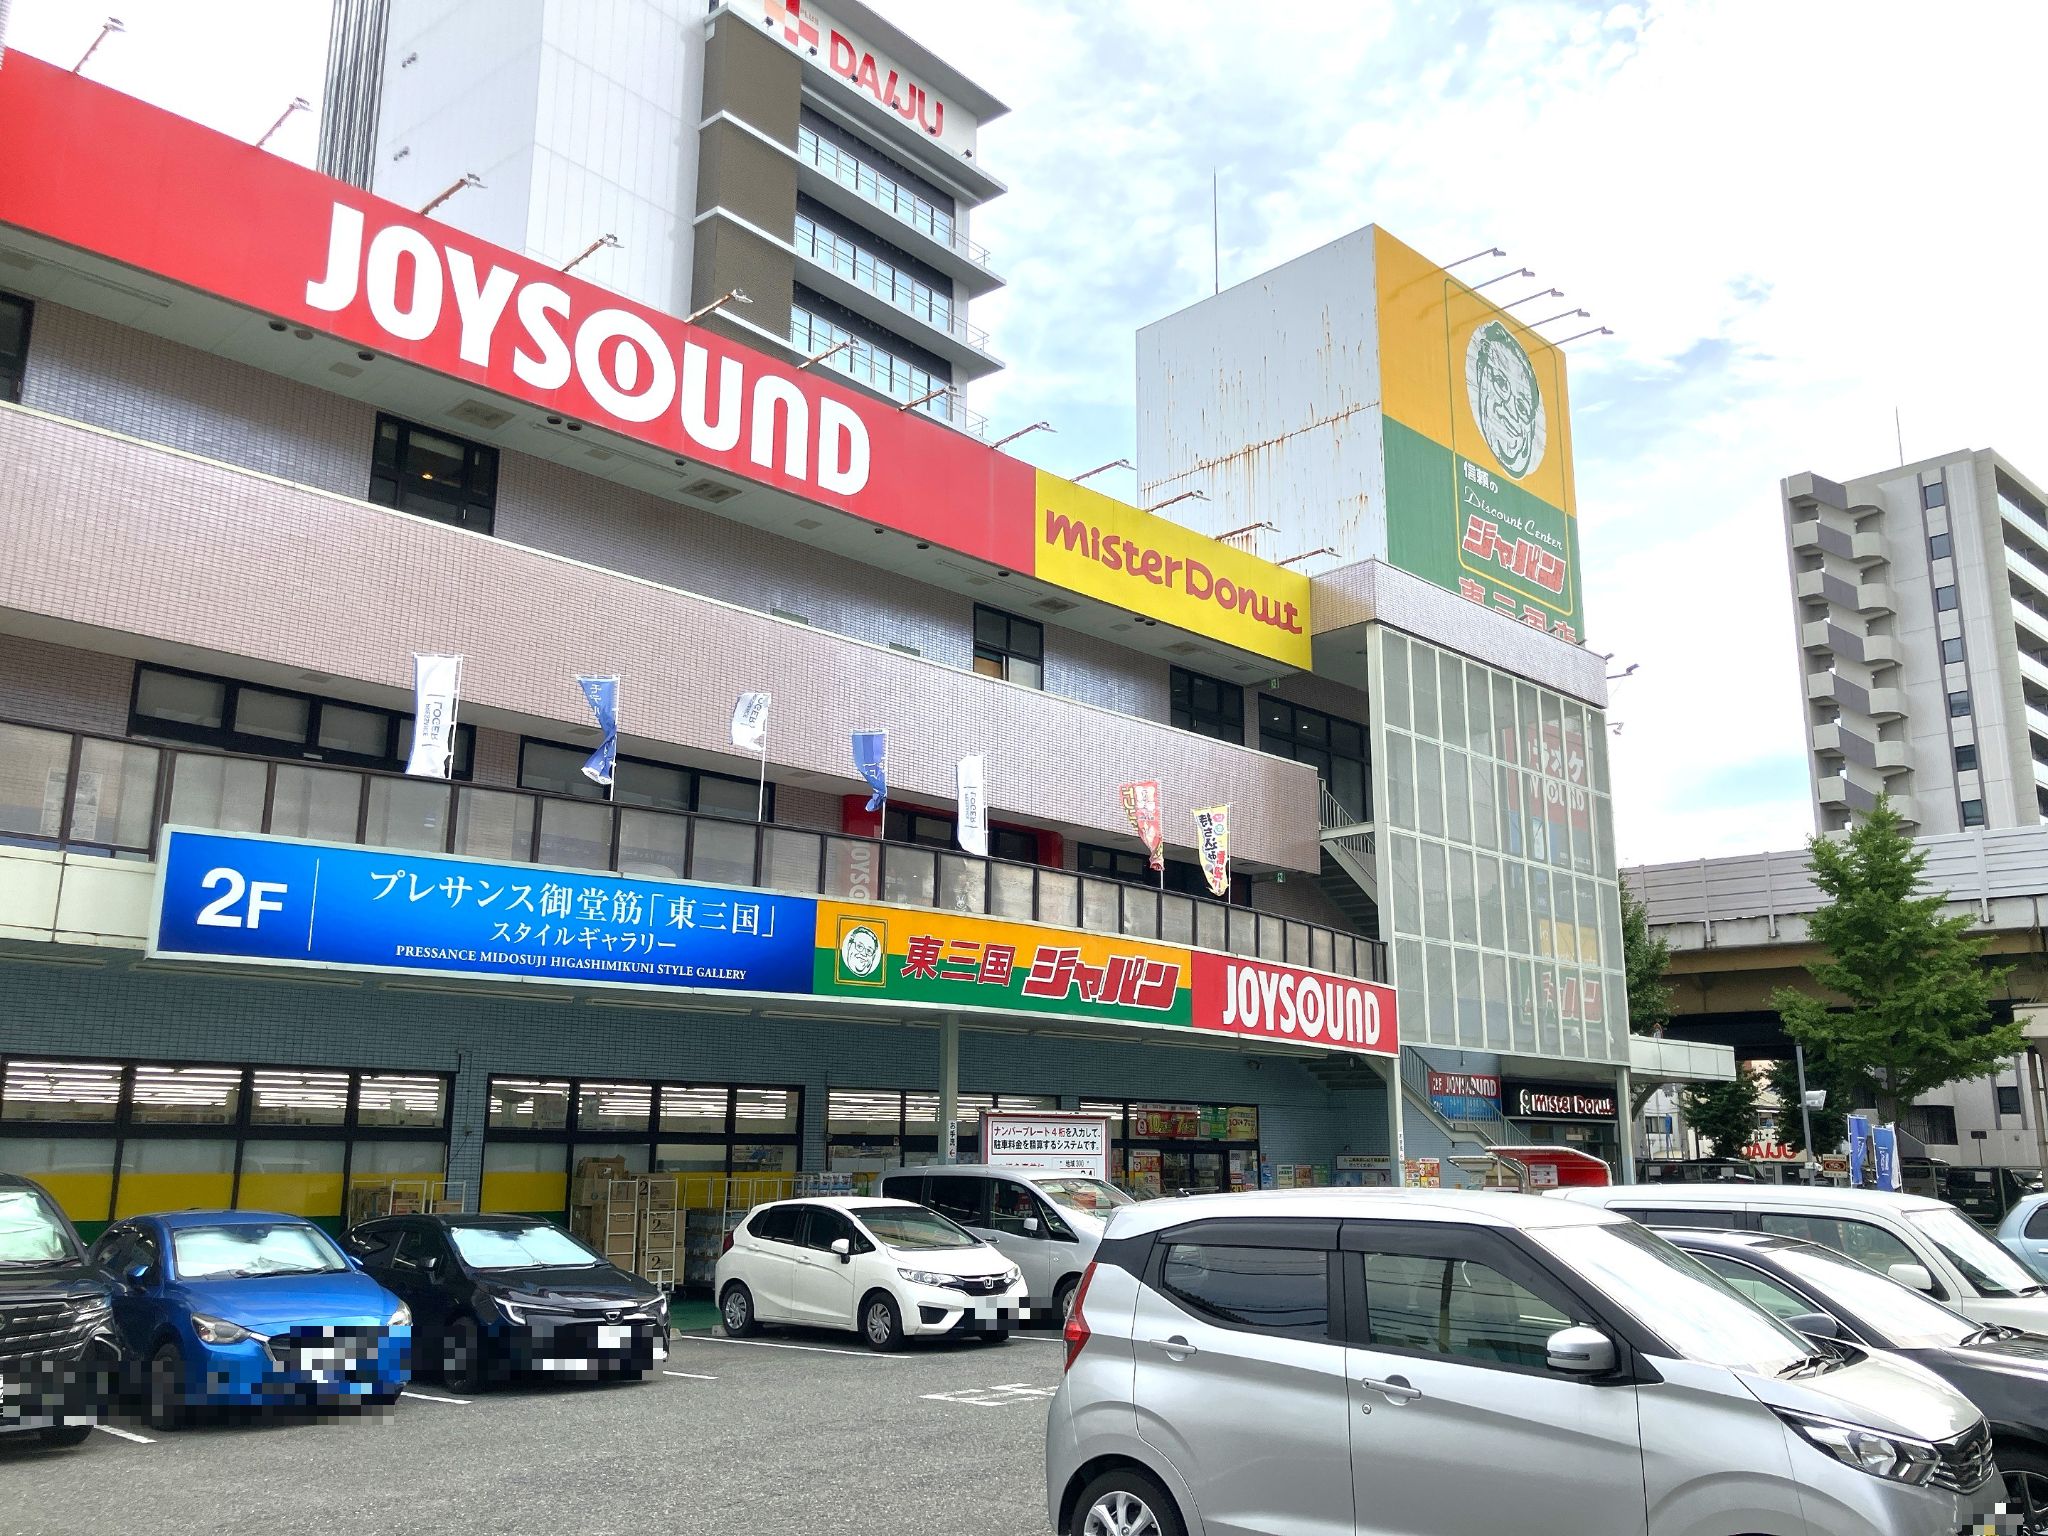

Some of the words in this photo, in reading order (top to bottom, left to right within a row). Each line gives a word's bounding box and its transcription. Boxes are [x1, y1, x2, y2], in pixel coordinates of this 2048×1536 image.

[829, 28, 943, 137] DAIJU
[305, 202, 870, 496] JOYSOUND
[1463, 460, 1498, 494] 信頼の
[1464, 486, 1522, 531] Discount
[1525, 520, 1562, 550] Center
[197, 867, 288, 929] 2F
[370, 869, 775, 938] プレサンス御堂筋「東三国」
[396, 945, 476, 962] PRESSANCE
[479, 951, 547, 968] MIDOSUJI
[550, 957, 654, 974] HIGASHIMIKUNI
[657, 963, 693, 977] STYLE
[696, 967, 747, 981] GALLERY
[490, 921, 677, 955] スタイルギャラリー
[900, 935, 1017, 988] 東三国
[1223, 965, 1381, 1045] JOYSOUND
